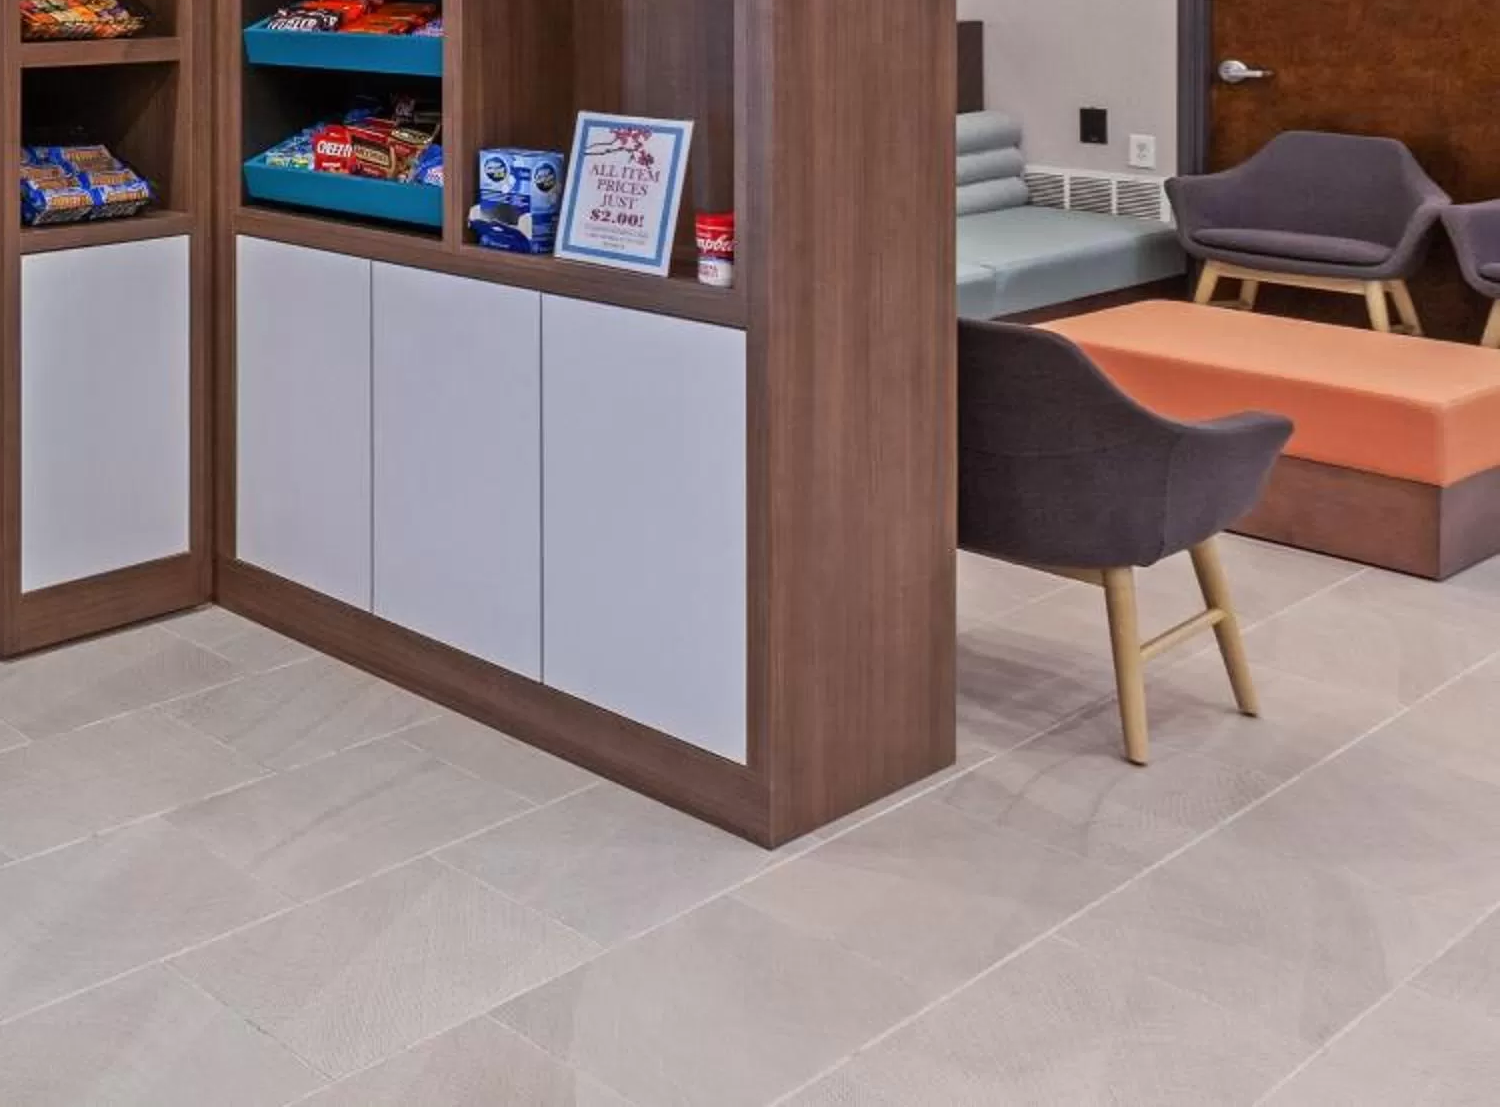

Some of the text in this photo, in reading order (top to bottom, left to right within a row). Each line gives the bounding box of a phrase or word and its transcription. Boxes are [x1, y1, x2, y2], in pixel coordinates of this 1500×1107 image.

[590, 164, 661, 183] ALL ITEM
[597, 178, 649, 196] PRICES
[599, 193, 639, 210] JUST
[589, 208, 645, 228] $2.00!
